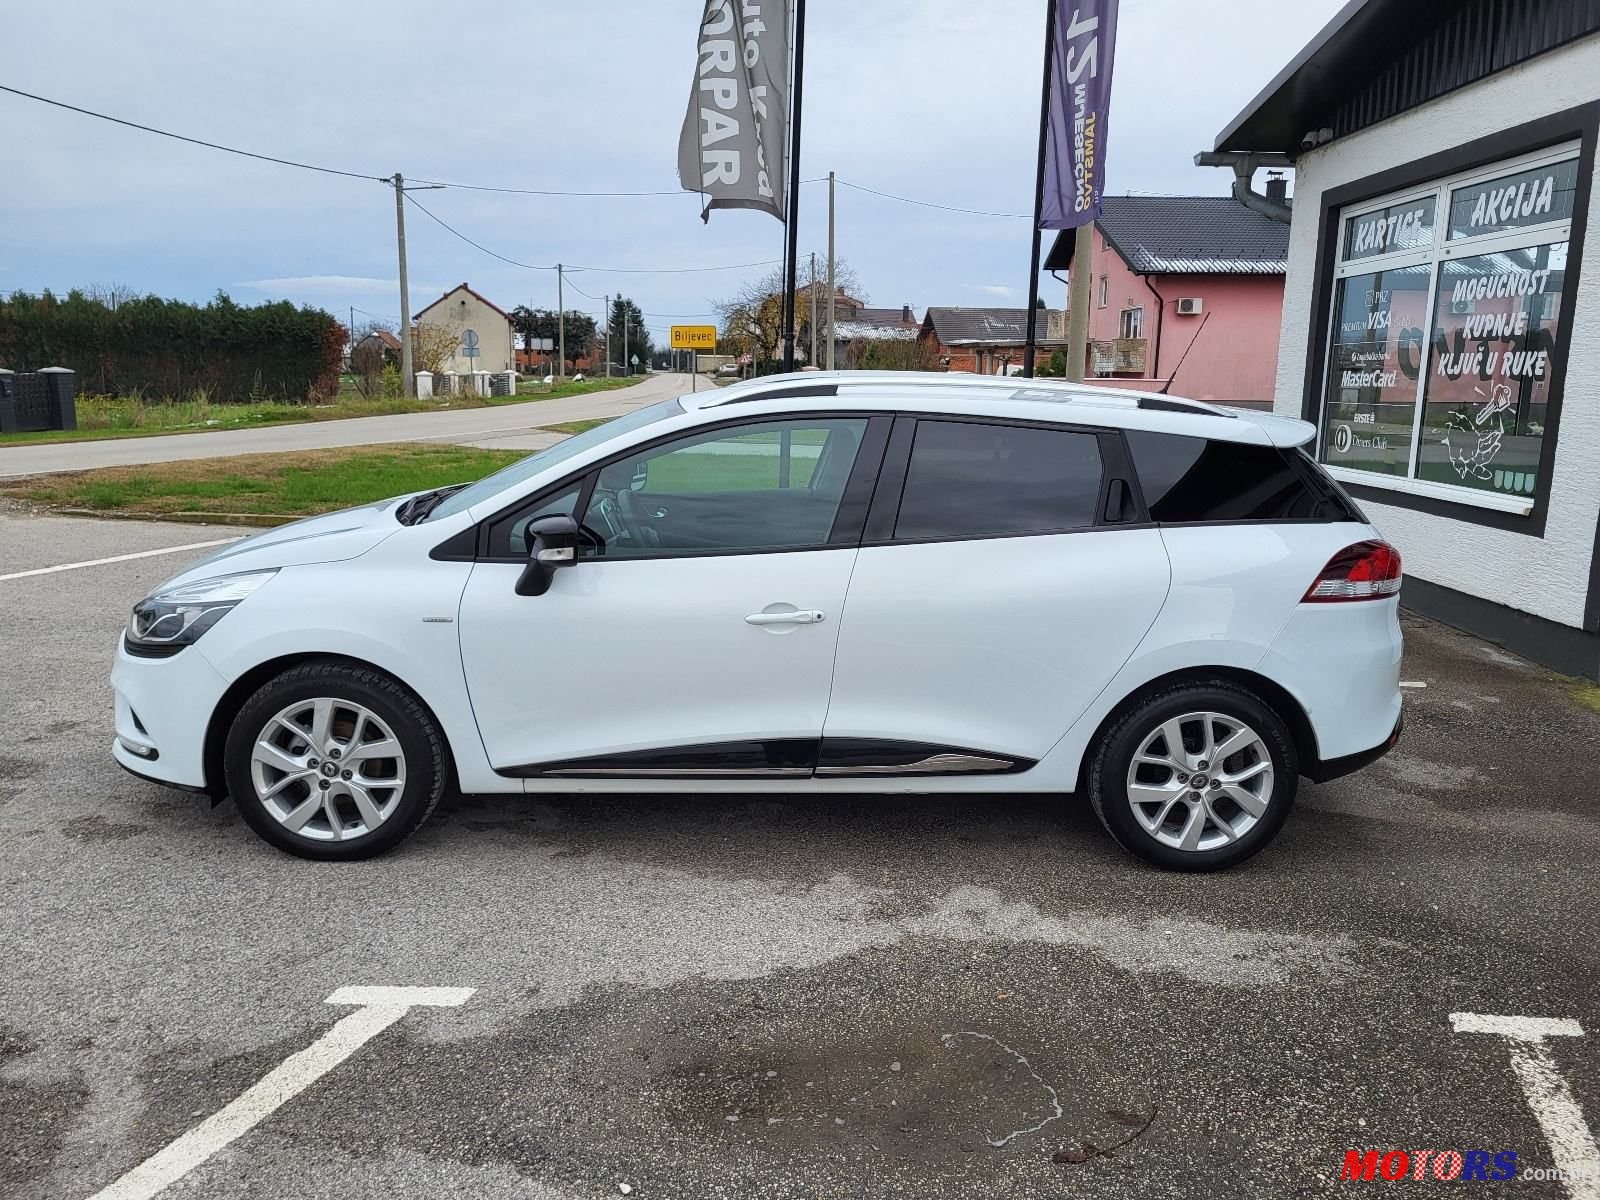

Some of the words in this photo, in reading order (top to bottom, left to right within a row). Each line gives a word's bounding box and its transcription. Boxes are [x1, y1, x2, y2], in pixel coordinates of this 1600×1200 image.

[1470, 176, 1553, 227] AKCIJA
[1354, 208, 1425, 253] KARTICE
[1367, 310, 1392, 329] VISA
[1463, 312, 1529, 339] KUPNJE
[674, 330, 712, 343] Biljevec
[1438, 345, 1485, 376] KLJUČ
[1485, 351, 1499, 376] U
[1501, 350, 1548, 377] RUKE
[1341, 369, 1397, 388] MasterCard
[1353, 413, 1371, 424] ERSTE
